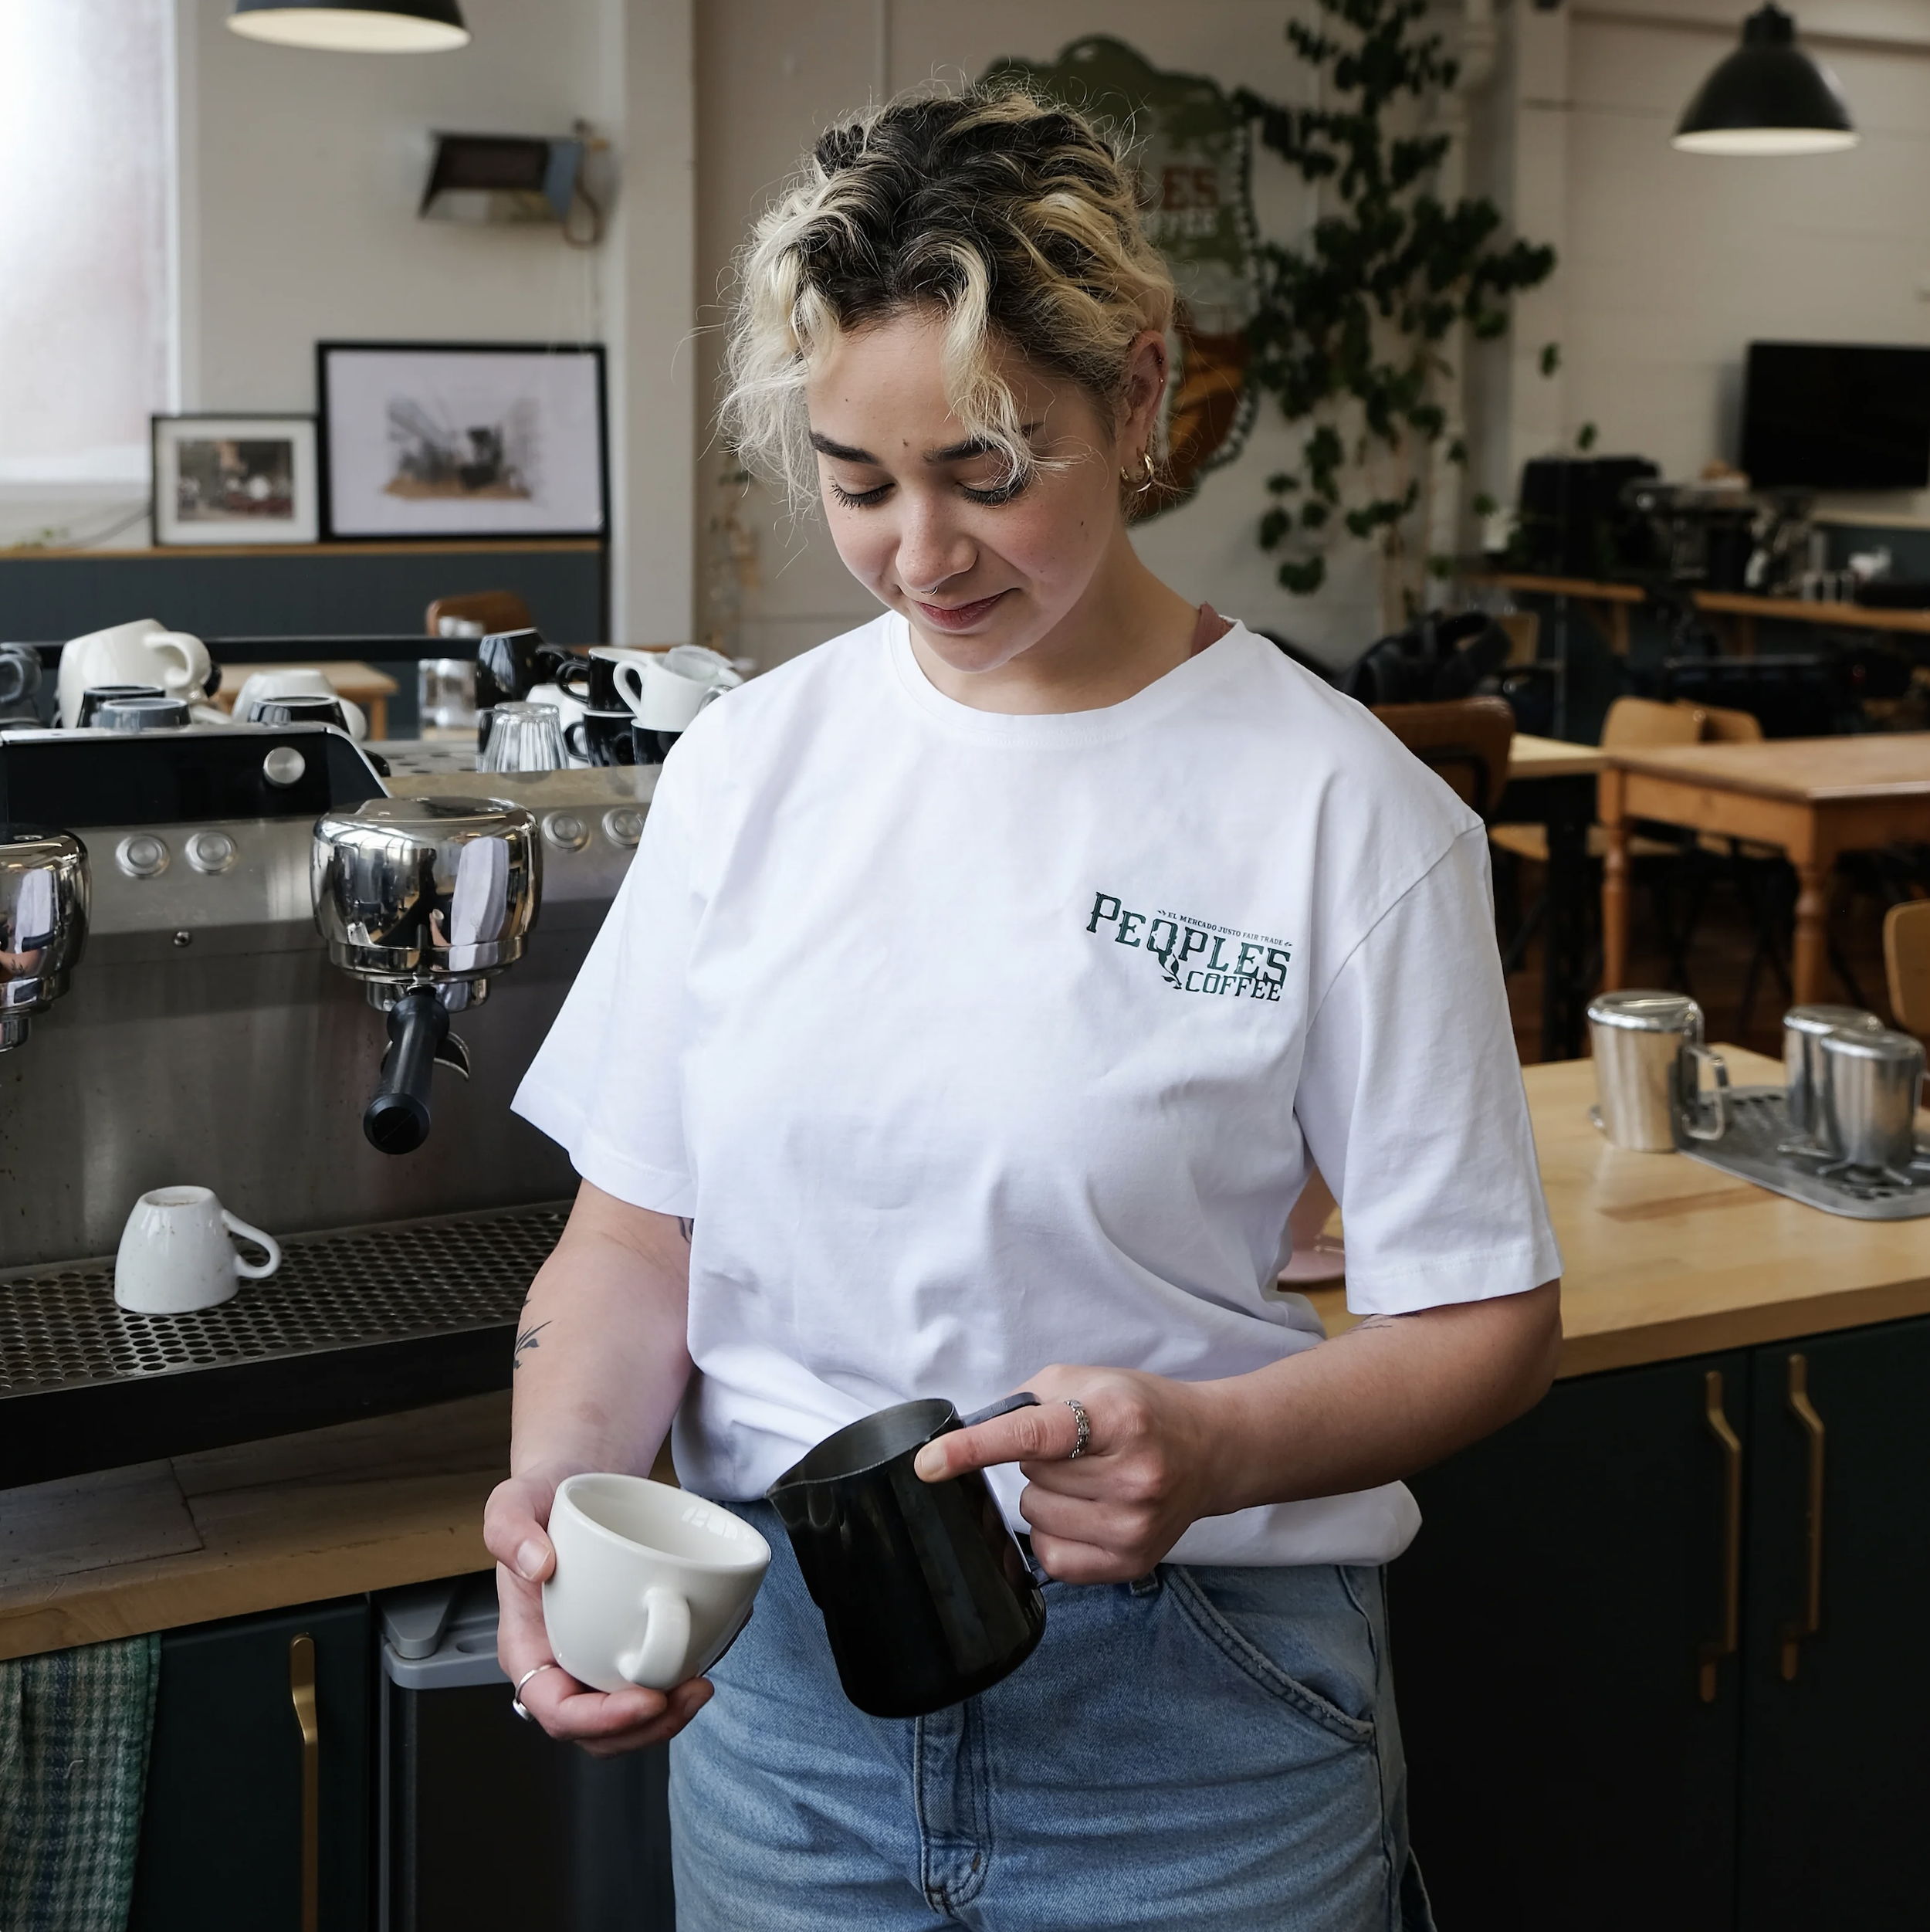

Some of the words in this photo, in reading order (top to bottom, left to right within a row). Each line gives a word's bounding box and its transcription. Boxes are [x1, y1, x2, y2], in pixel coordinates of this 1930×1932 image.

[1085, 891, 1292, 988] PEOPLES
[1179, 915, 1217, 931] MERCADO
[1217, 927, 1241, 937] JUSTO
[1242, 932, 1260, 941] FAIR
[1260, 935, 1284, 946] TRADE
[1184, 970, 1285, 1002] COFFEE
